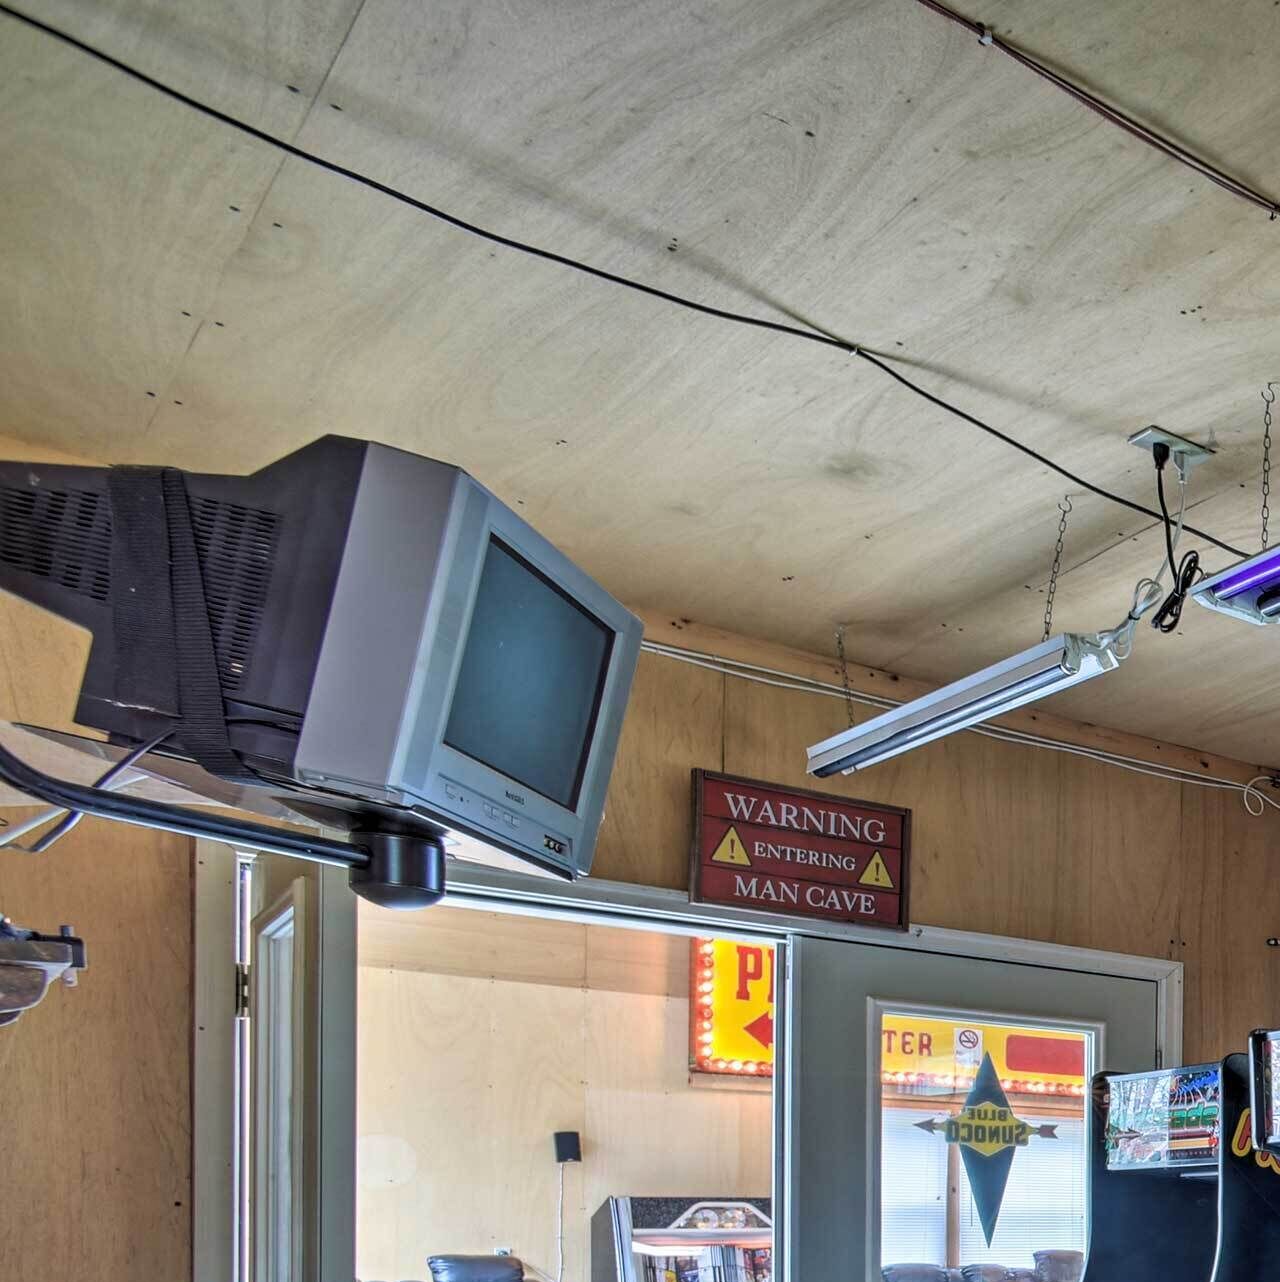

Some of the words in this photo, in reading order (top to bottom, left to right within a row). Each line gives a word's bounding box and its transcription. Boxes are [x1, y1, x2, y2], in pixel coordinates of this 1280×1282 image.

[724, 792, 886, 843] WARNING
[754, 841, 856, 871] ENTERING
[734, 875, 799, 904] MAN
[805, 886, 876, 915] CAVE
